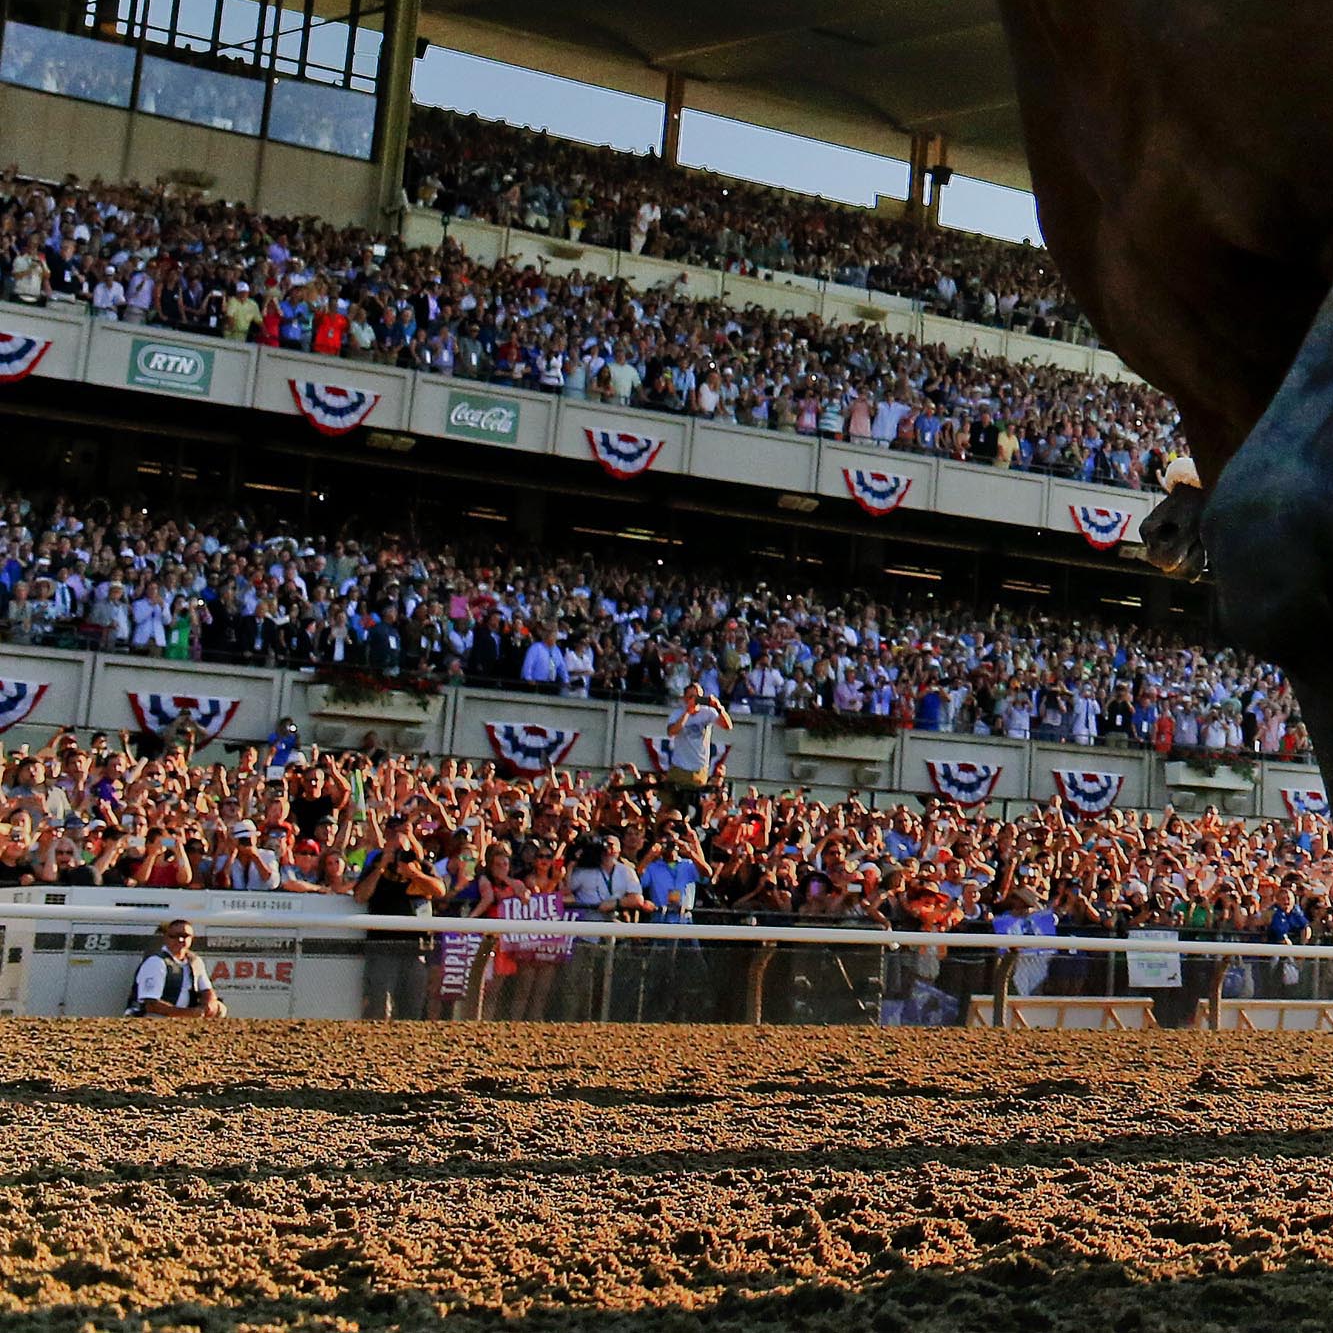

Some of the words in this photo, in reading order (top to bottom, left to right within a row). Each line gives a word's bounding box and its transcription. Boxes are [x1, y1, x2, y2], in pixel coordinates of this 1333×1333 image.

[149, 352, 195, 375] RTN
[502, 894, 558, 921] TRIPLE
[84, 934, 111, 951] 85
[211, 960, 294, 985] ABLE
[439, 935, 467, 996] TRIPLE
